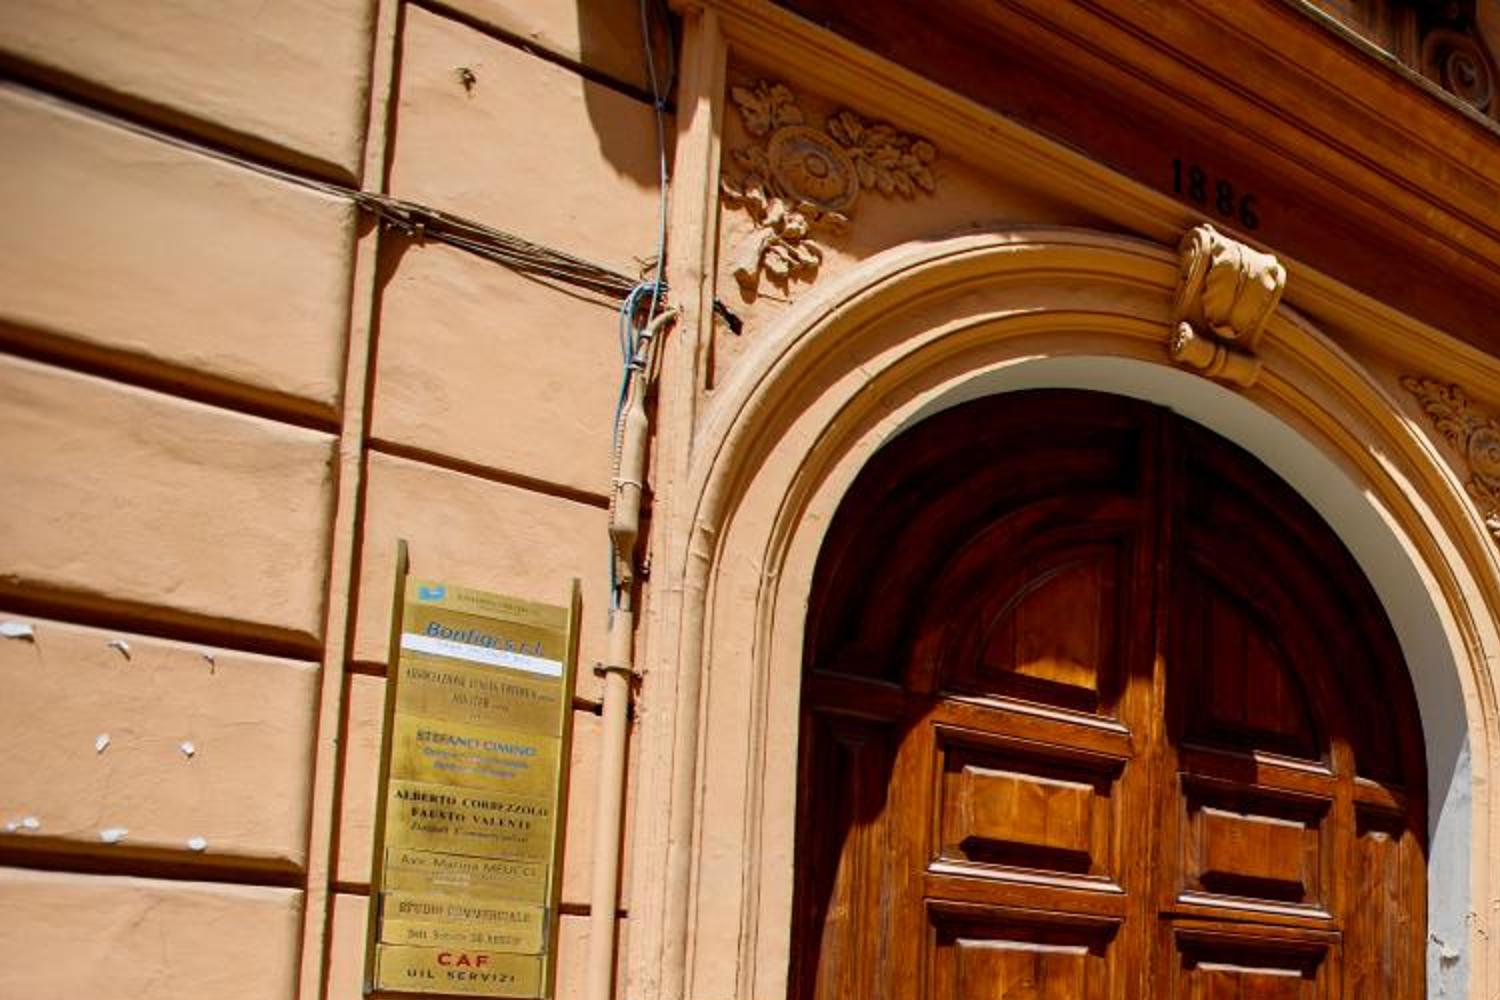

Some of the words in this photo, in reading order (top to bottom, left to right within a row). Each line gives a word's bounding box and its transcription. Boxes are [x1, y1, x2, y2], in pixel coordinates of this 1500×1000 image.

[1173, 159, 1260, 229] 1886
[394, 788, 457, 806] ALBERTO
[411, 806, 467, 824] FAUSTO
[436, 951, 491, 969] CAF
[406, 967, 436, 980] UIL
[446, 970, 517, 984] SERVIZI
